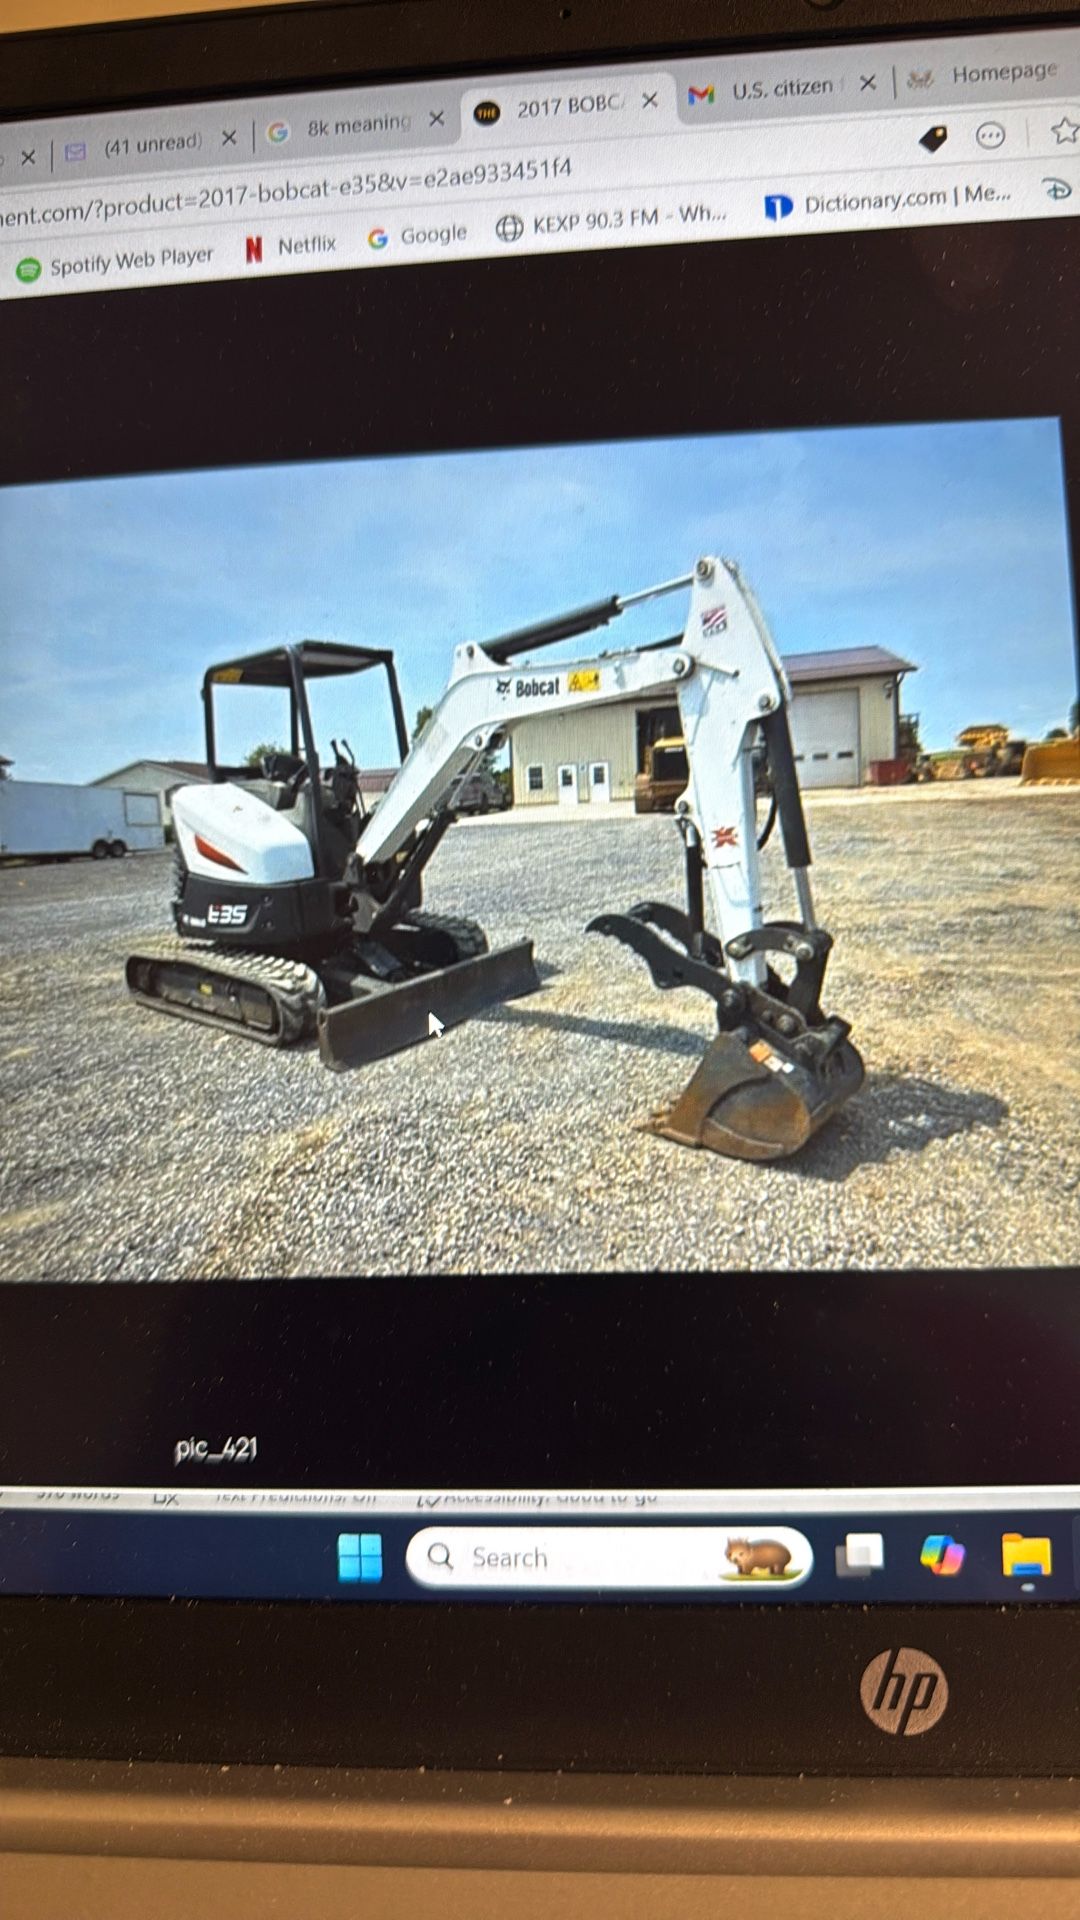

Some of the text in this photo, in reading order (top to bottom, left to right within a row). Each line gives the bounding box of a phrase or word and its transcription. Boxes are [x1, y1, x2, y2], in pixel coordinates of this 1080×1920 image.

[953, 61, 1058, 84] Homepage
[733, 77, 833, 100] U.S. citizen
[518, 98, 561, 119] 2017
[308, 113, 411, 138] 8k meaning
[104, 139, 130, 160] (41
[804, 190, 948, 215] Dictionary.com
[964, 183, 1011, 203] Me...
[533, 214, 580, 235] KEXP
[586, 211, 624, 231] 90.3
[630, 207, 660, 227] FM
[679, 203, 727, 223] Wh...
[278, 234, 337, 256] Netflix
[401, 223, 468, 247] Google
[51, 248, 214, 279] Spotify Web Player
[515, 676, 560, 698] Bobcat
[174, 1435, 258, 1468] pic_421
[472, 1545, 548, 1569] Search
[873, 1648, 939, 1735] hp
